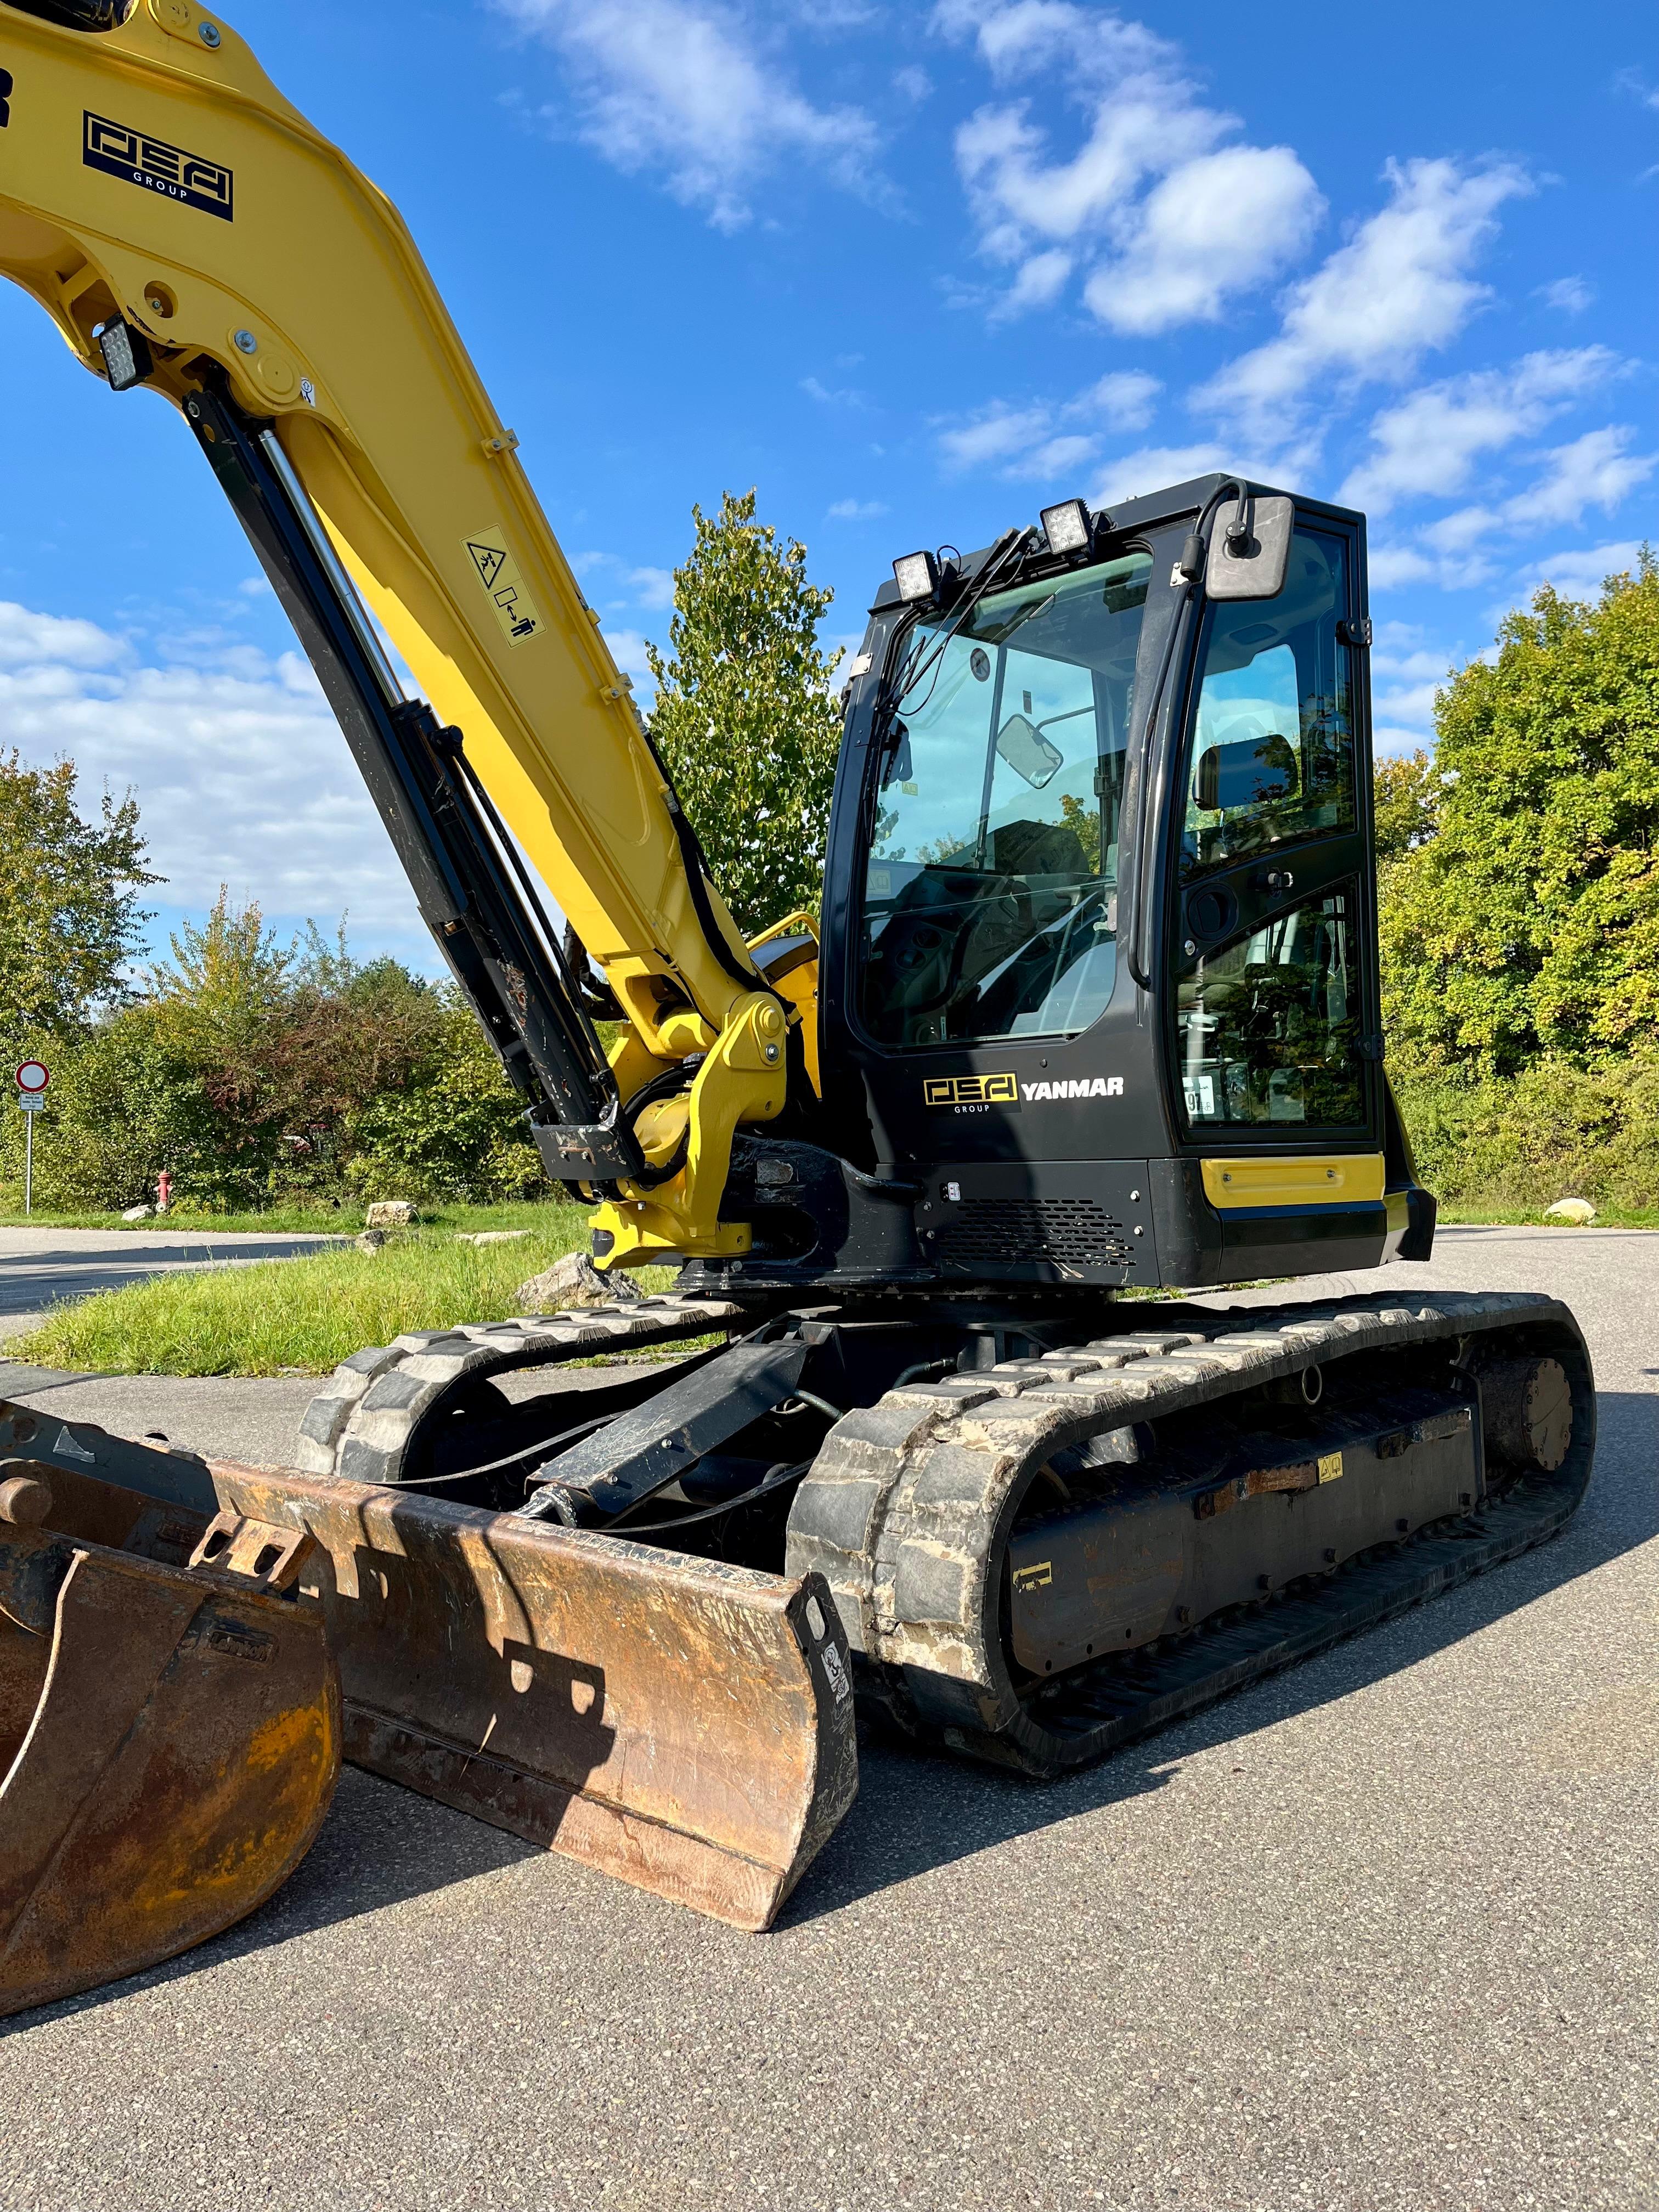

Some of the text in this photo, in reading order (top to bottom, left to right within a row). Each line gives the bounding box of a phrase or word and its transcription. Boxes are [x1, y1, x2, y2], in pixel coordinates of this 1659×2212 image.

[133, 172, 187, 199] GROUP
[1021, 1076, 1124, 1101] YANMAR
[954, 1104, 990, 1114] GROUP
